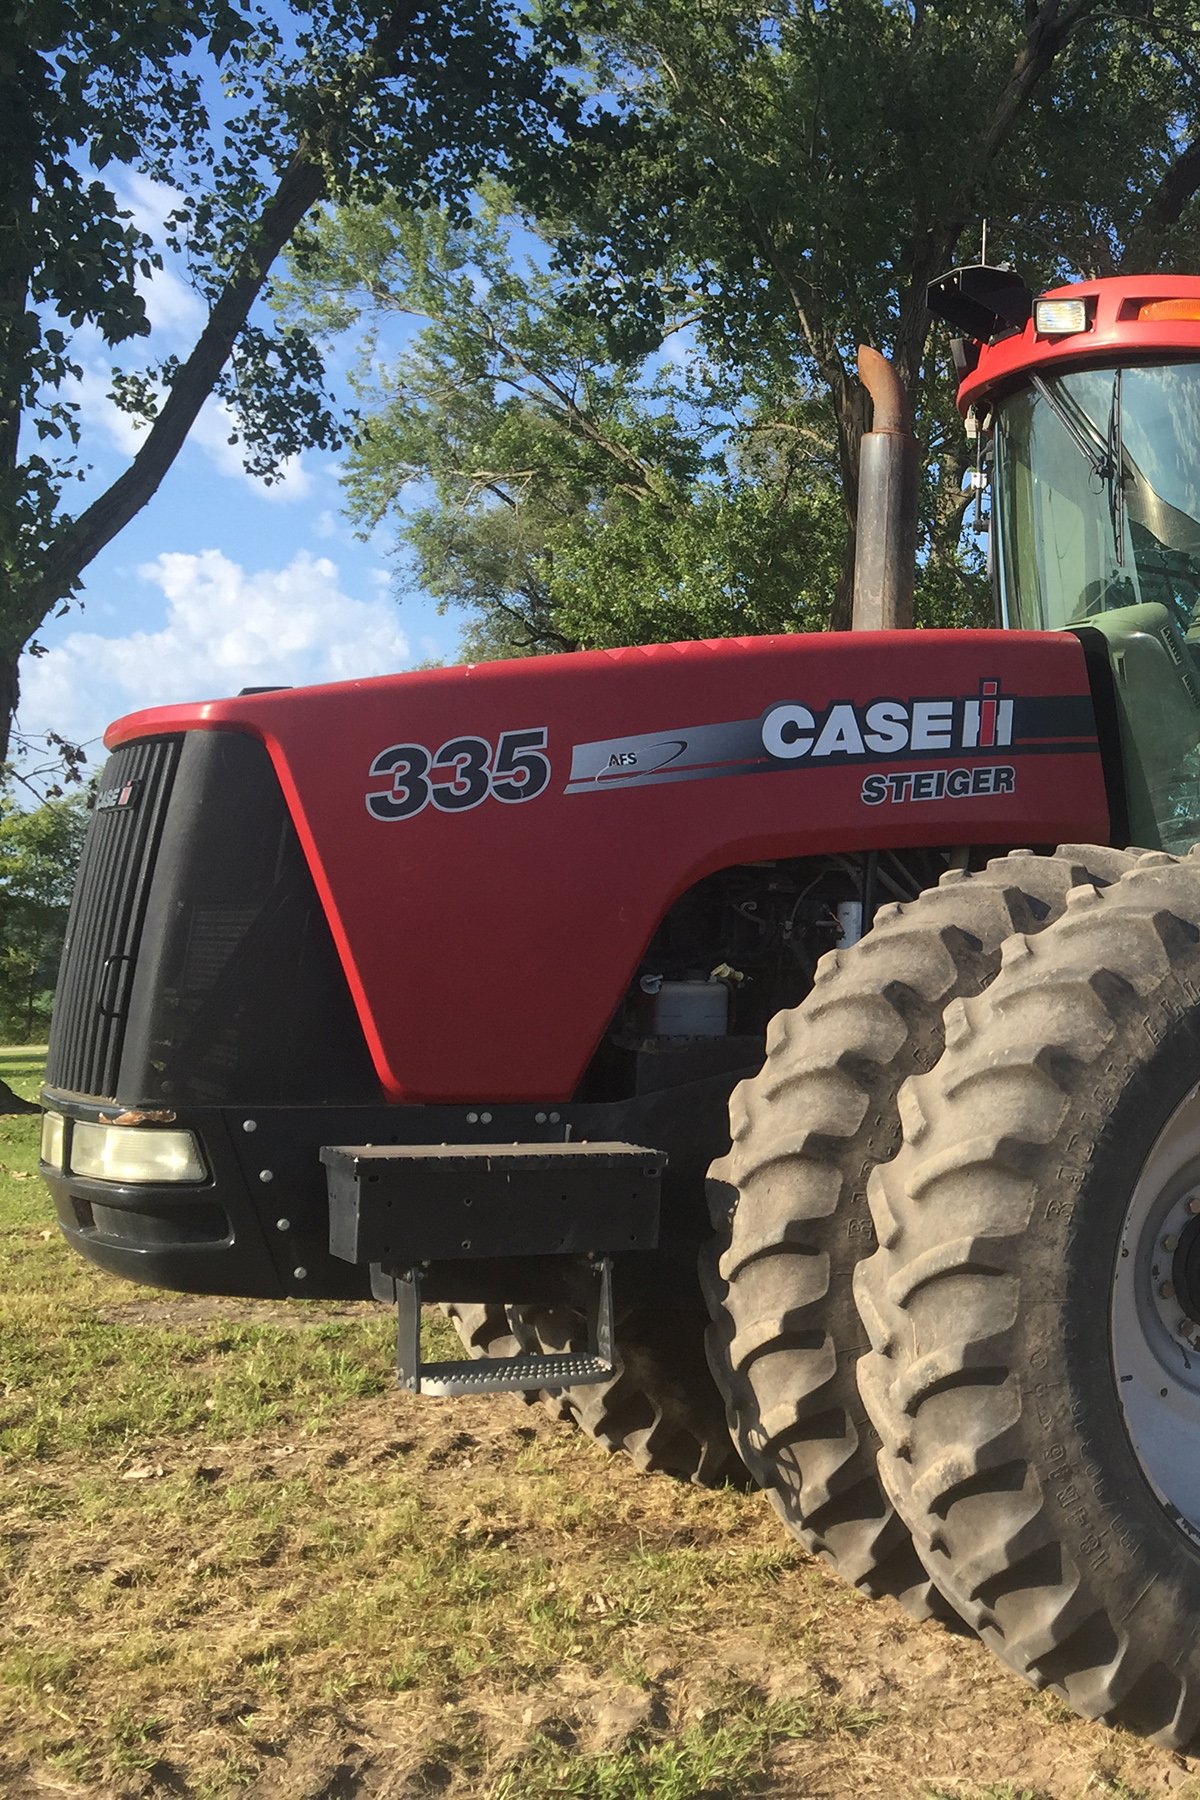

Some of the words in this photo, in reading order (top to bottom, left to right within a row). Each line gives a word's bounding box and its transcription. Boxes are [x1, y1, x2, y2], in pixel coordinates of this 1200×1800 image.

[762, 701, 953, 760] CASE
[365, 726, 552, 822] 335
[608, 752, 638, 767] AFS
[861, 766, 1015, 805] STEIGER
